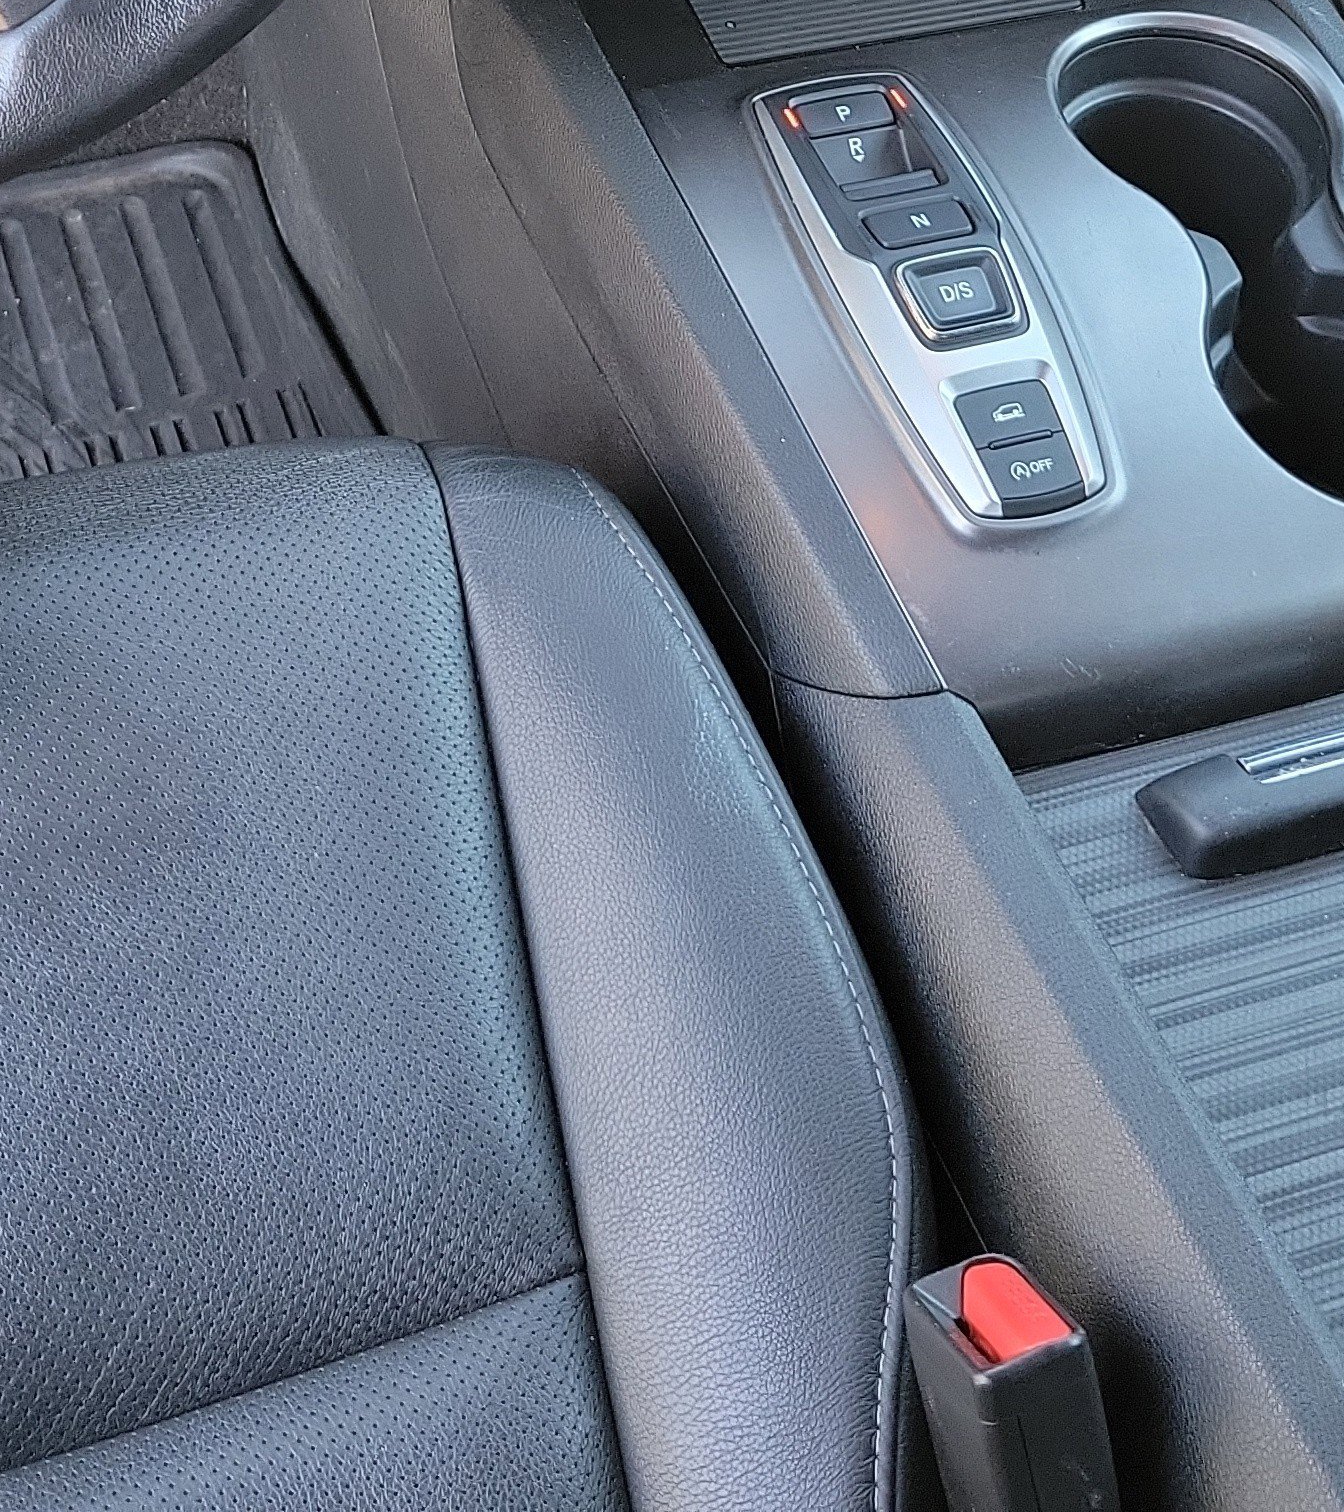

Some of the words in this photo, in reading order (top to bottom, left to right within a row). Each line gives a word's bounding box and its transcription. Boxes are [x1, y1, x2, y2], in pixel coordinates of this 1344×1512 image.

[835, 105, 851, 122] P
[848, 137, 864, 155] R
[910, 213, 931, 228] N
[939, 270, 974, 303] D/S
[1030, 457, 1054, 473] OFF
